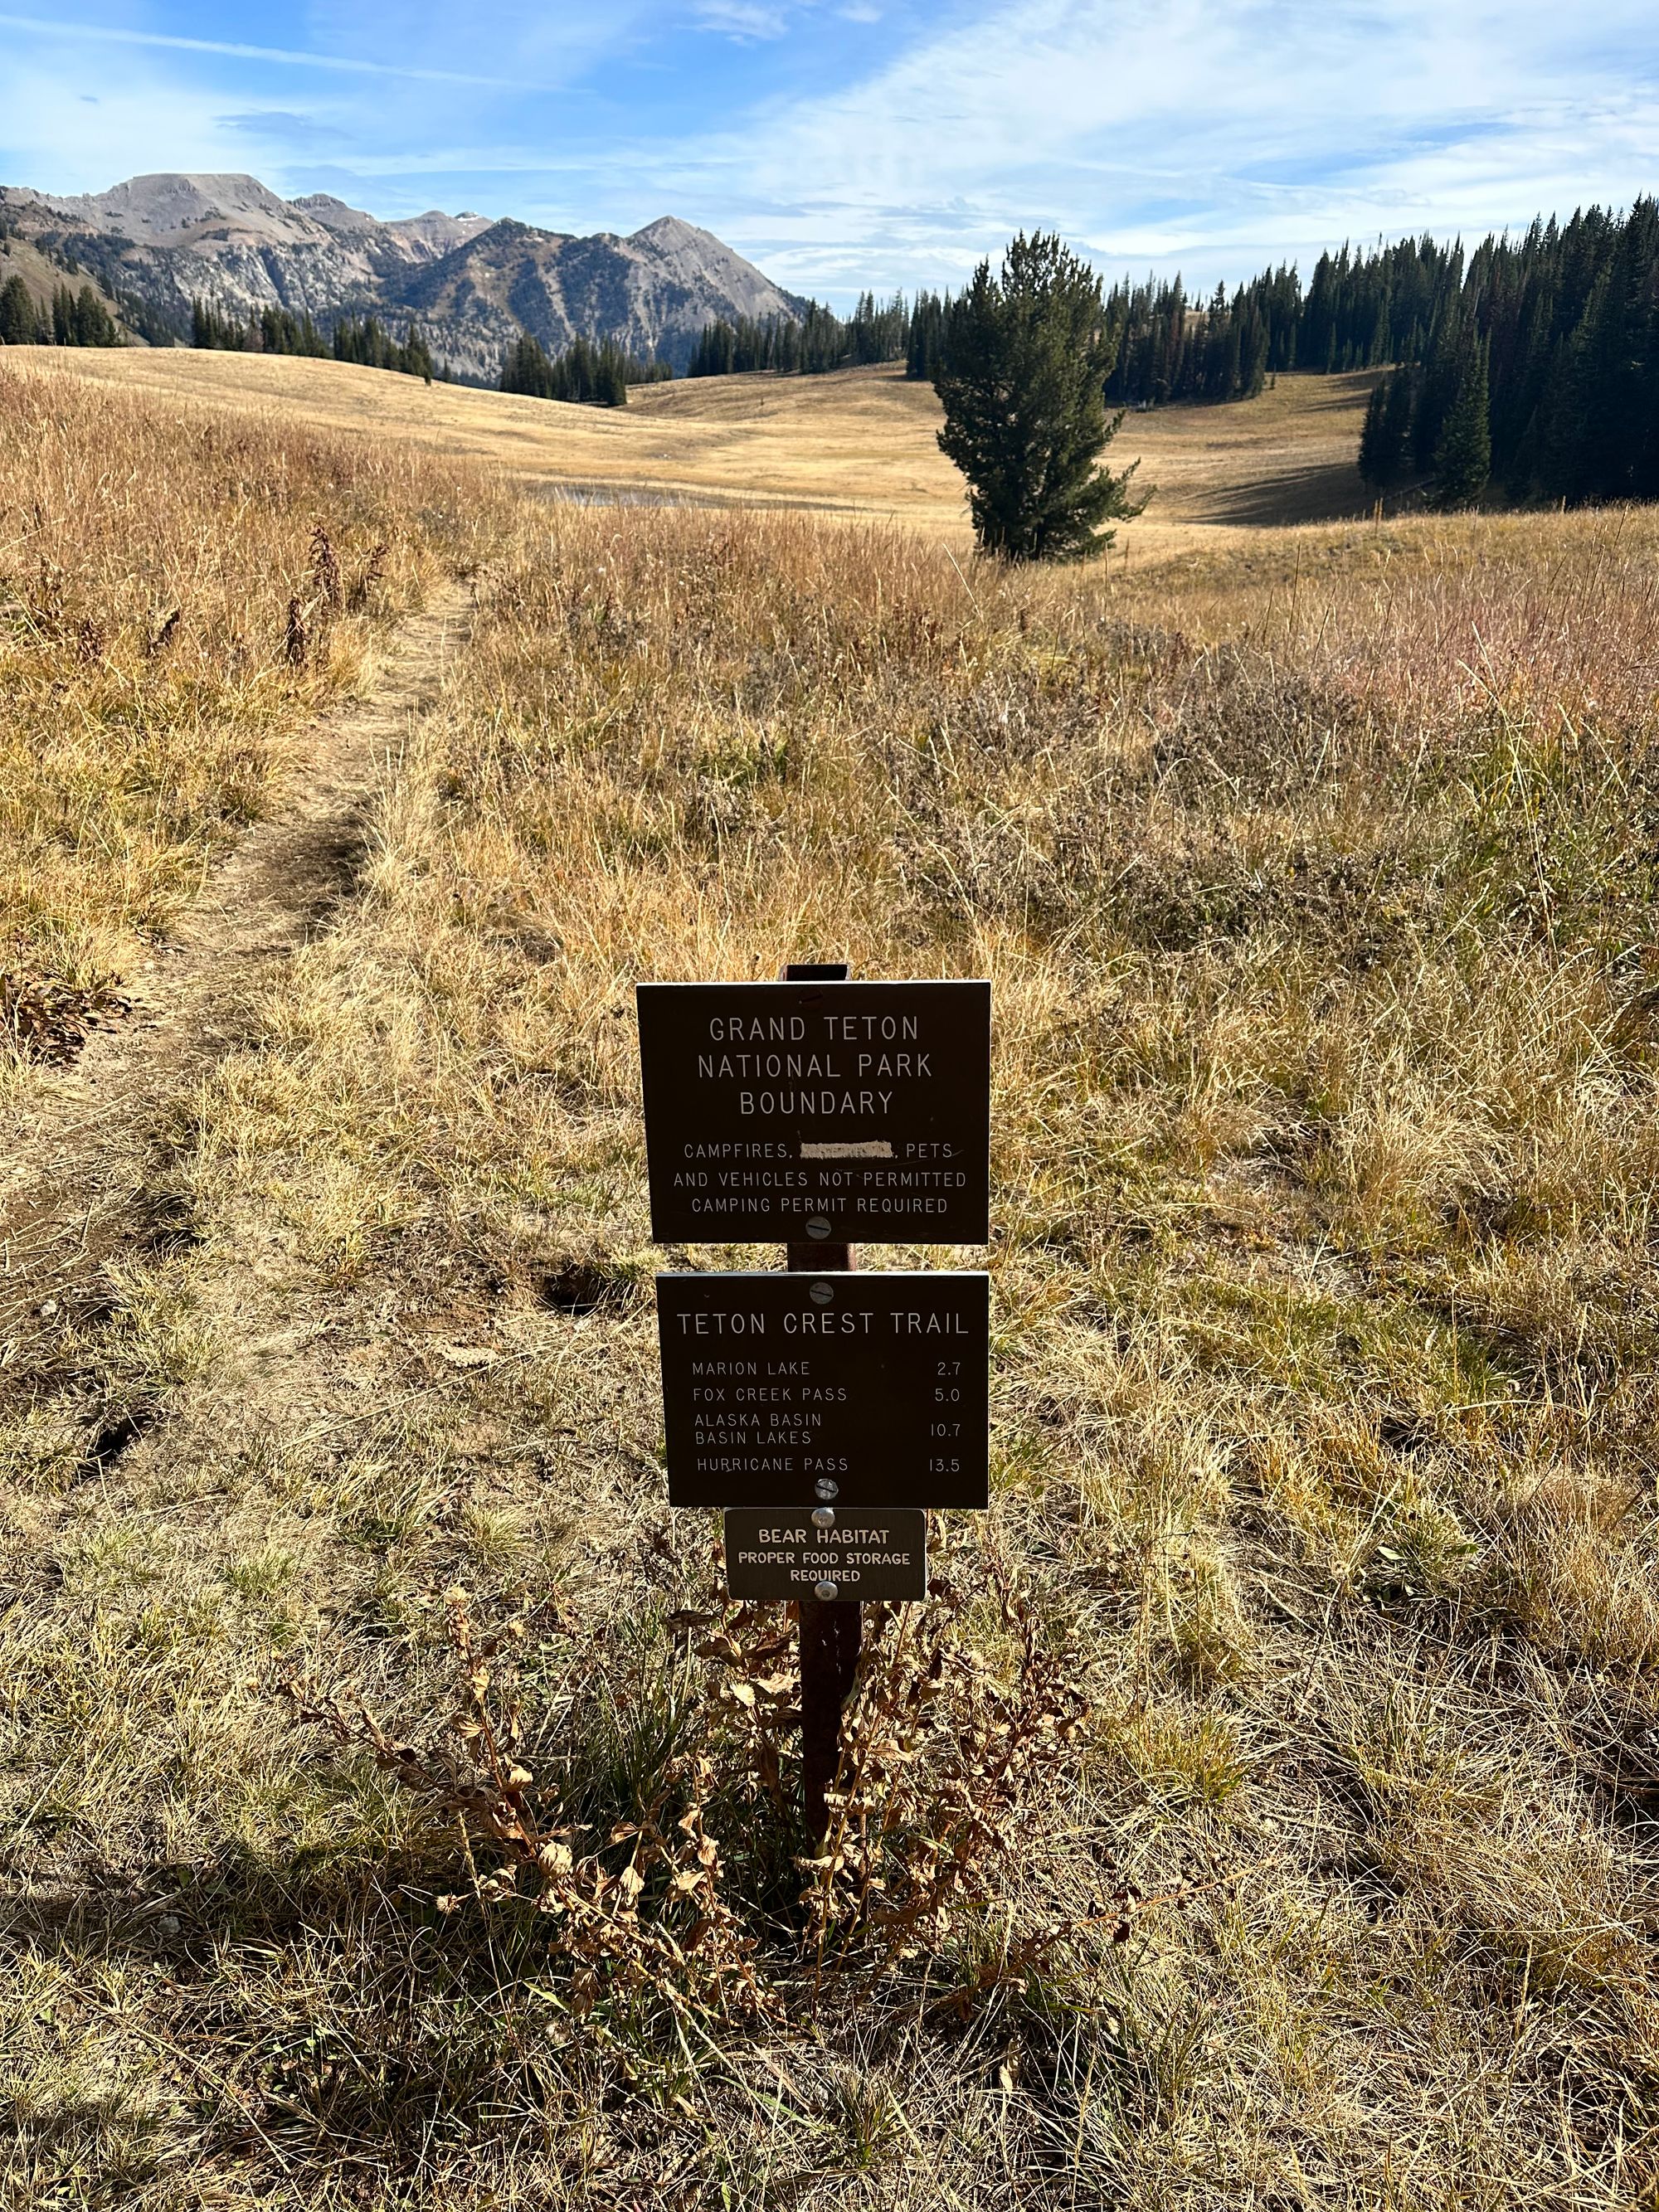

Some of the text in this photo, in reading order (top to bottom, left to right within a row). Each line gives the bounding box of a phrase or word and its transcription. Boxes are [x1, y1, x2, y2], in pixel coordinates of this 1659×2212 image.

[709, 1016, 917, 1041] GRAND TETON
[698, 1053, 932, 1078] NATIONAL PARK
[740, 1091, 893, 1115] BOUNDARY
[684, 1143, 794, 1159] CAMPFIRES,
[907, 1143, 952, 1158] PETS
[674, 1172, 966, 1187] AND VEHICLES NOT PERMITTED
[692, 1198, 947, 1213] CAMPING PERMIT REQUIRED
[676, 1312, 969, 1334] TETON CREST TRAIL
[693, 1361, 809, 1375] MARION LAKE
[937, 1362, 961, 1375] 2.7
[693, 1388, 847, 1402] FOX CREEK PASS
[935, 1388, 960, 1402] 5.0
[694, 1413, 821, 1427] ALASKA BASIN
[931, 1423, 961, 1437] 10.7
[695, 1431, 811, 1445] BASIN LAKES
[698, 1457, 848, 1472] HURRICANE PASS
[929, 1459, 960, 1472] 13.5
[758, 1529, 889, 1544] BEAR HABITAT
[738, 1551, 911, 1565] PROPER FOOD STORAGE
[790, 1569, 861, 1582] REQUIRED
